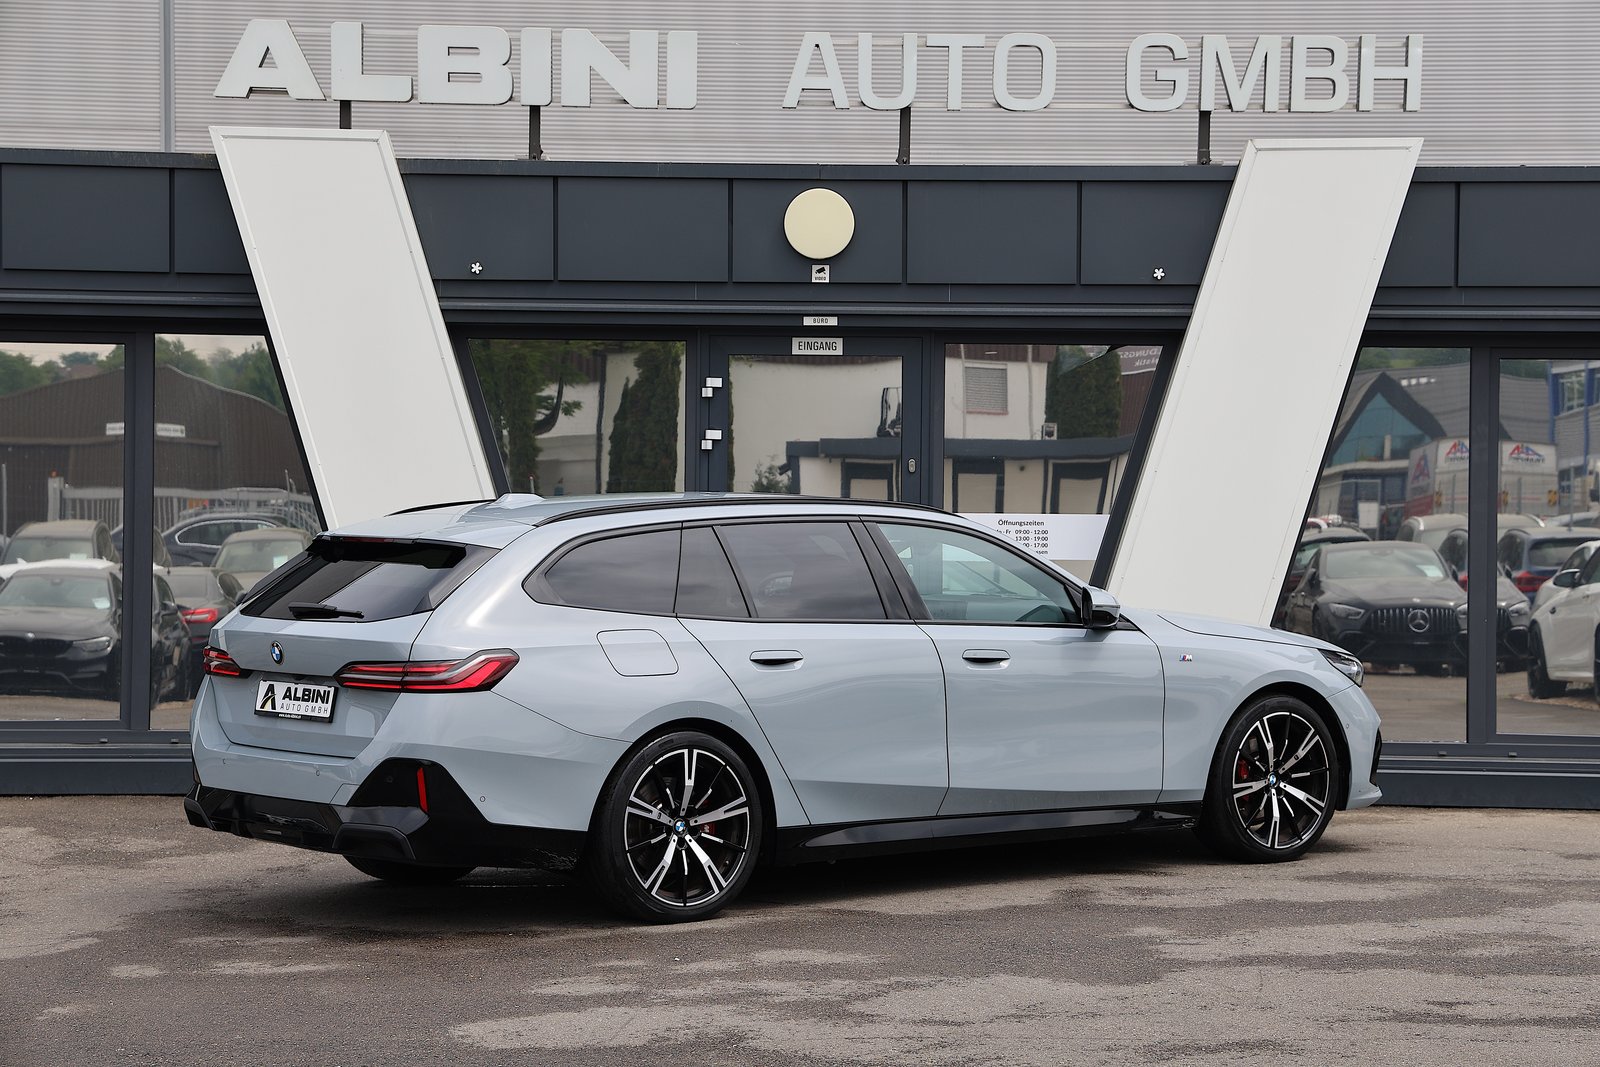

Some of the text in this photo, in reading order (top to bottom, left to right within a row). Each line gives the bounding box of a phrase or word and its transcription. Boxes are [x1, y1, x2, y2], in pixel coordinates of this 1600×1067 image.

[213, 19, 1424, 113] ALBINI AUTO GMBH
[798, 341, 837, 351] EINGANG
[998, 519, 1045, 527] Öffnungszeiten
[282, 687, 330, 704] ALBINI
[280, 703, 328, 714] AUTO GMBH
